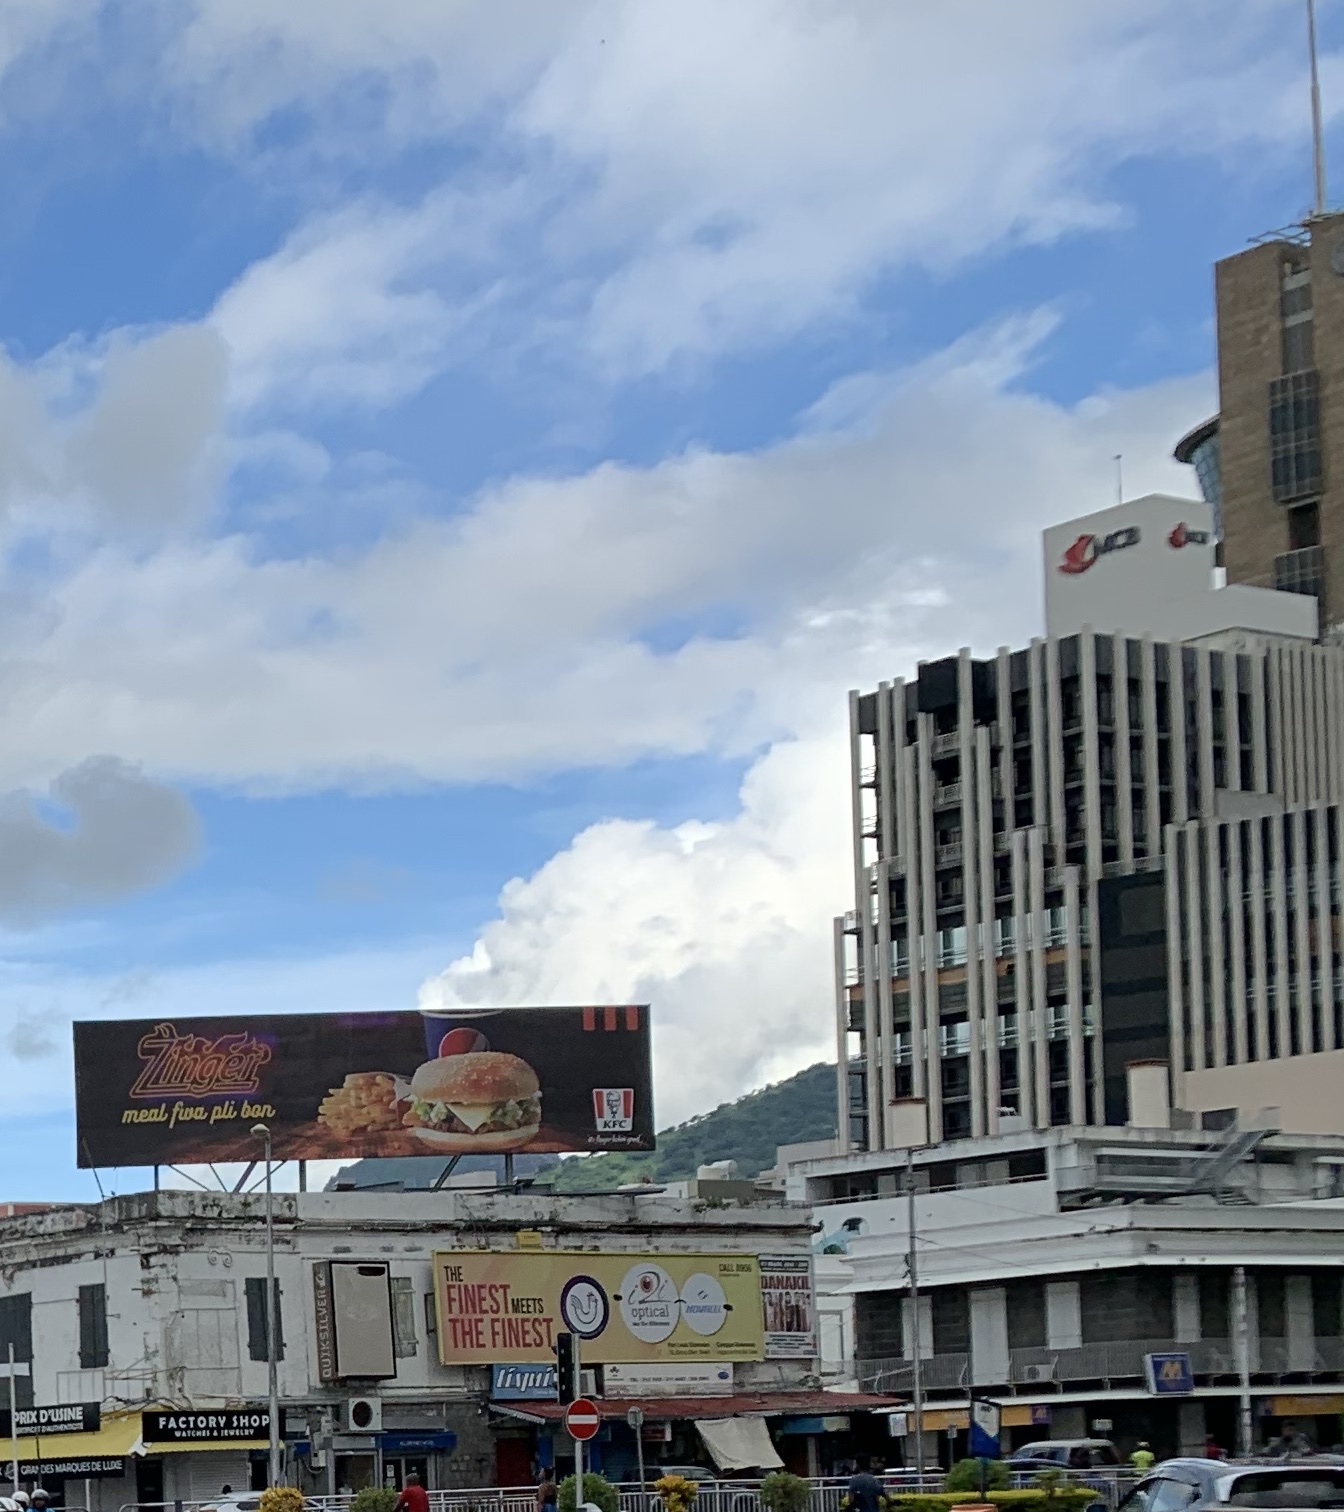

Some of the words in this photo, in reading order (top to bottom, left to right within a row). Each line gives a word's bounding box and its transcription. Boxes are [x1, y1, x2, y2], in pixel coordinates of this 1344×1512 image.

[130, 1023, 271, 1098] Zinger
[122, 1102, 168, 1123] meal
[209, 1101, 238, 1125] pli
[240, 1100, 276, 1119] bon
[603, 1120, 627, 1129] KFC
[443, 1265, 464, 1282] THE
[447, 1284, 510, 1315] FINEST
[511, 1297, 544, 1314] MEETS
[631, 1305, 670, 1320] optical
[316, 1289, 332, 1378] QUIKSILVER
[448, 1318, 486, 1348] THE
[491, 1317, 553, 1348] FINEST
[13, 1410, 38, 1425] PRIX
[39, 1406, 83, 1423] D'USINE
[159, 1416, 226, 1429] FACTORY
[232, 1415, 270, 1427] SHOP
[174, 1429, 211, 1438] WATCHES
[221, 1428, 255, 1437] JEWELRY
[55, 1461, 91, 1474] MARQUES
[91, 1461, 102, 1471] DE
[103, 1460, 123, 1470] LUXE
